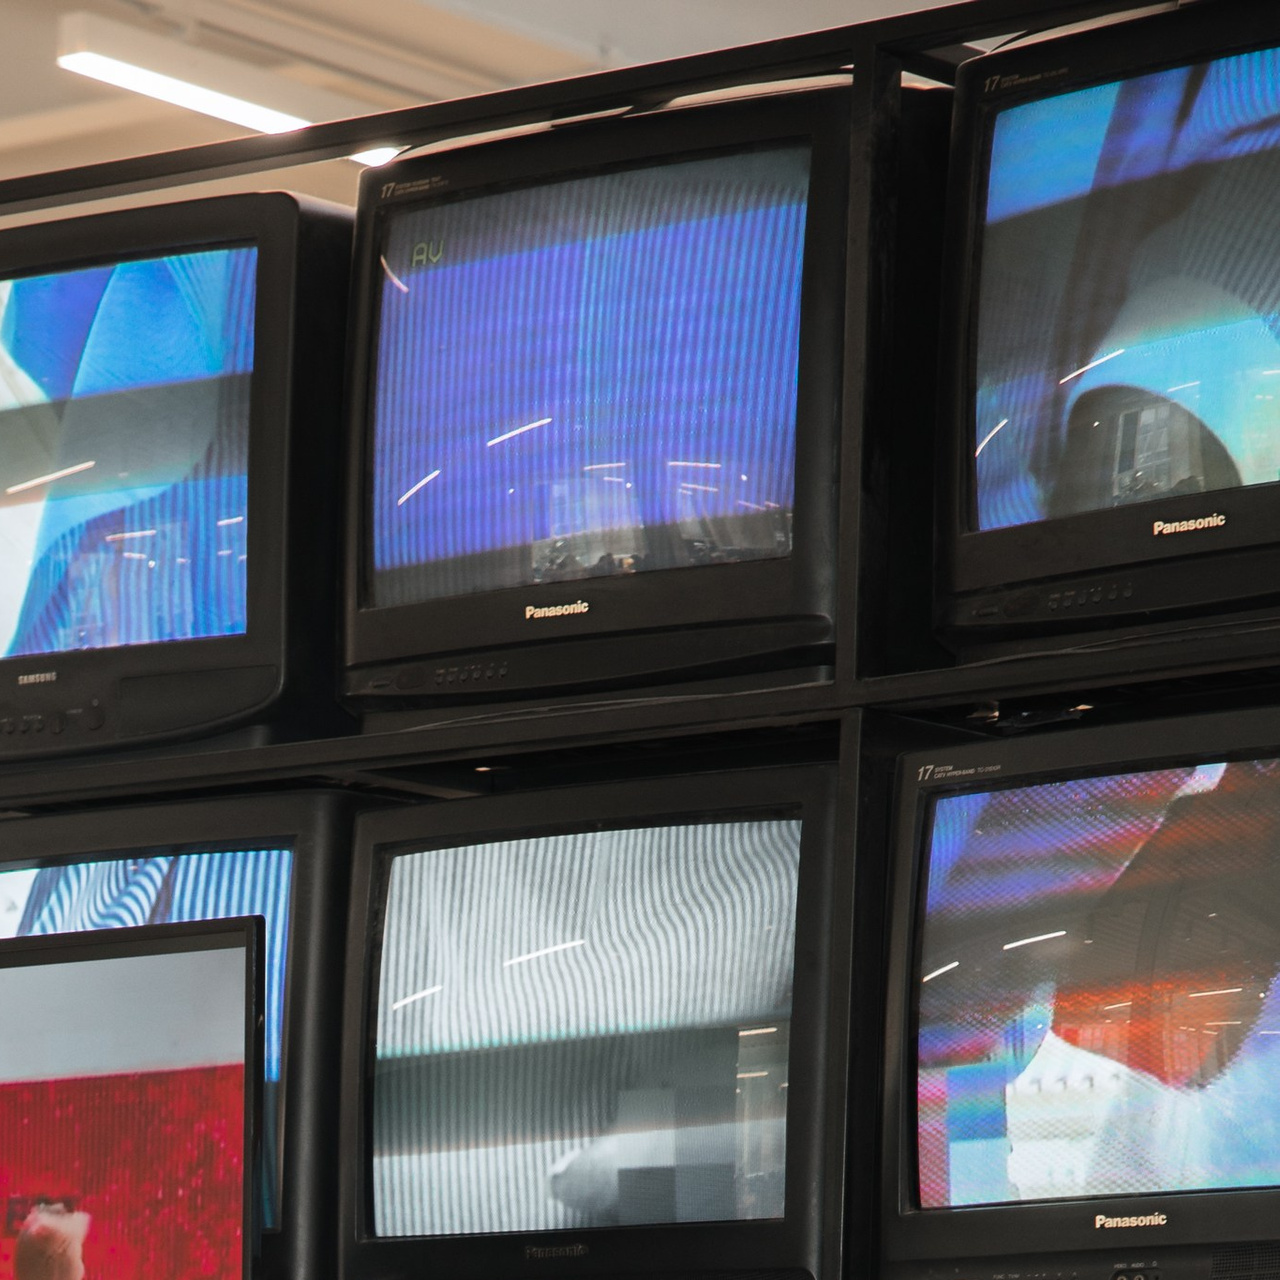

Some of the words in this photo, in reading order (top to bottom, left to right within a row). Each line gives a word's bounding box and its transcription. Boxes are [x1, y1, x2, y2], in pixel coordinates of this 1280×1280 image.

[412, 240, 444, 267] AV
[1153, 513, 1226, 536] Panasonic
[525, 600, 589, 619] Panasonic
[918, 764, 934, 781] 17
[1096, 1212, 1168, 1229] Panasonic
